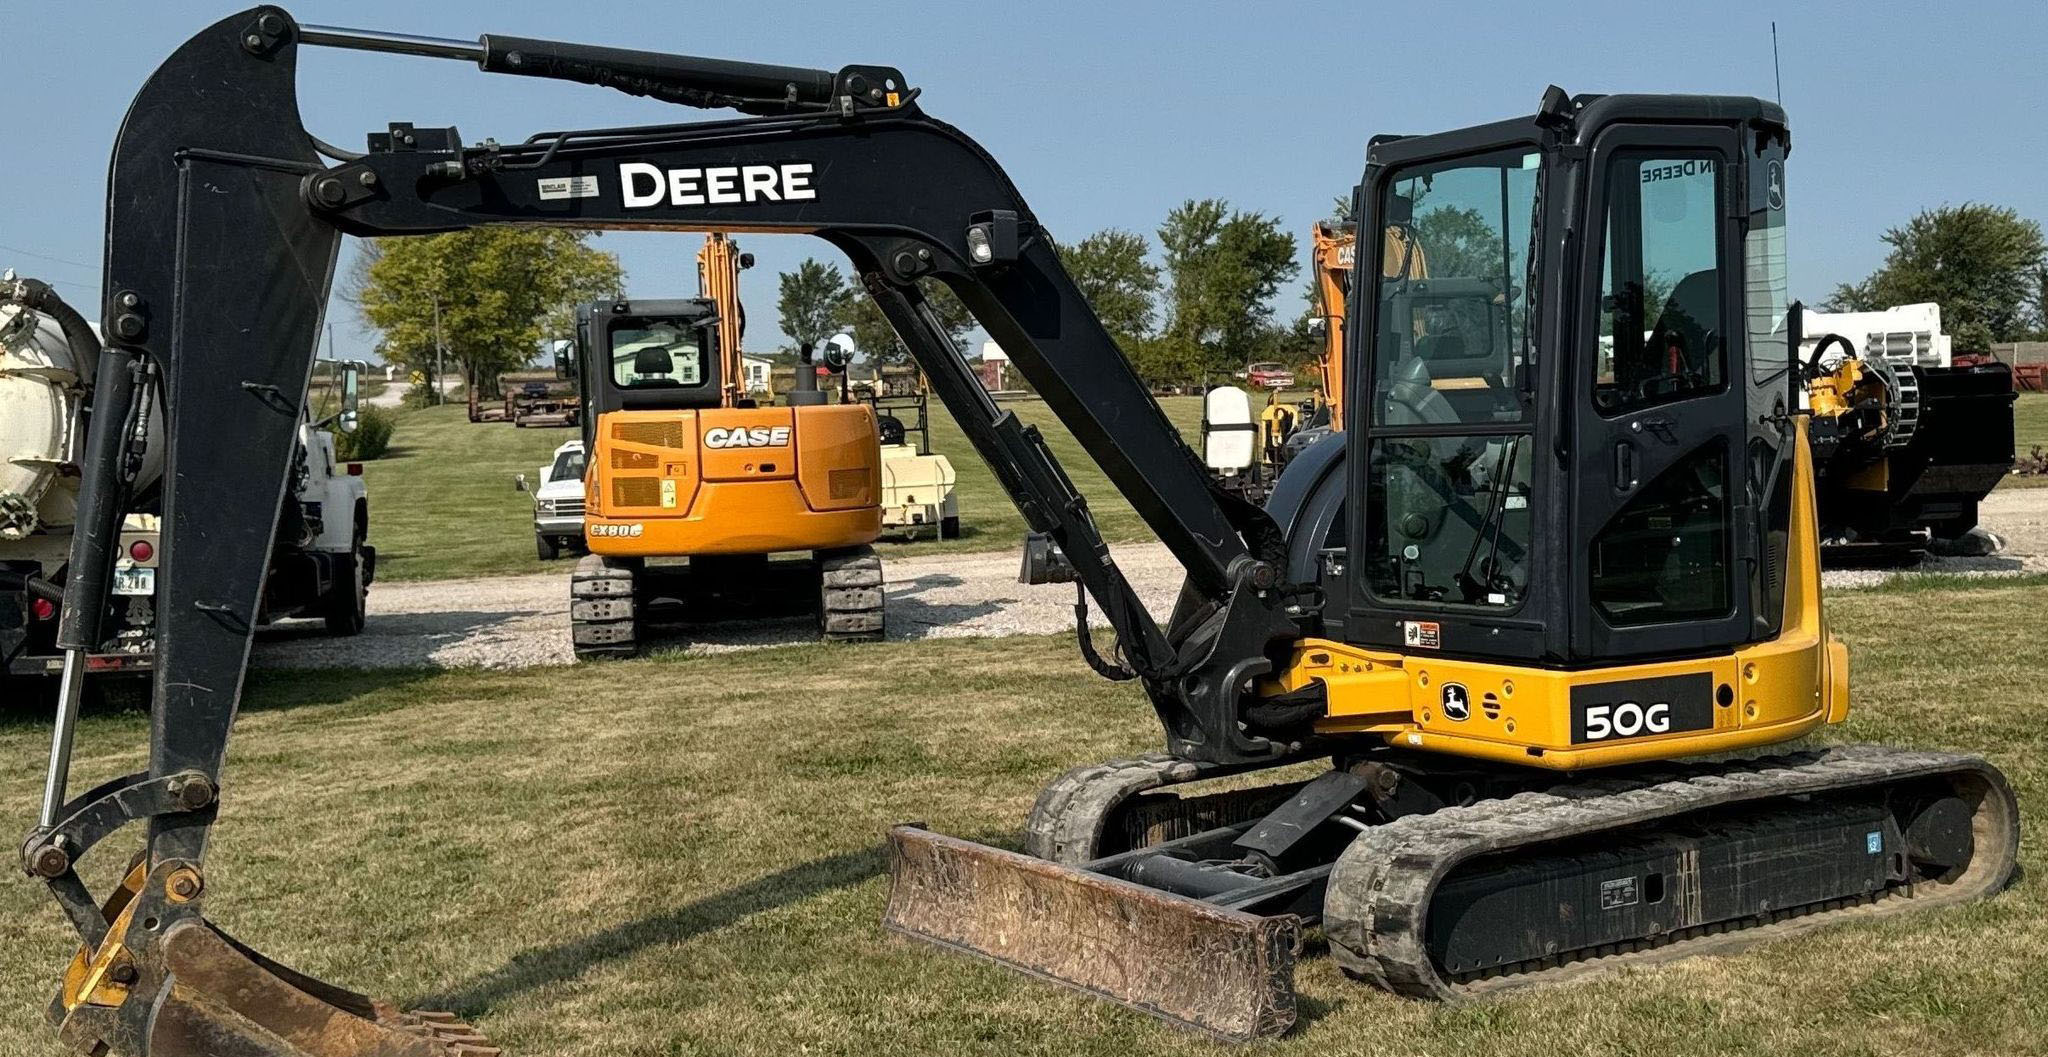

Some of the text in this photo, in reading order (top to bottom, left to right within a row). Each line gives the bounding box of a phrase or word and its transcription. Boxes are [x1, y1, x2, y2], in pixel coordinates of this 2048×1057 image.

[619, 163, 816, 208] DEERE
[704, 426, 792, 449] CASE
[1586, 703, 1670, 739] 50G
